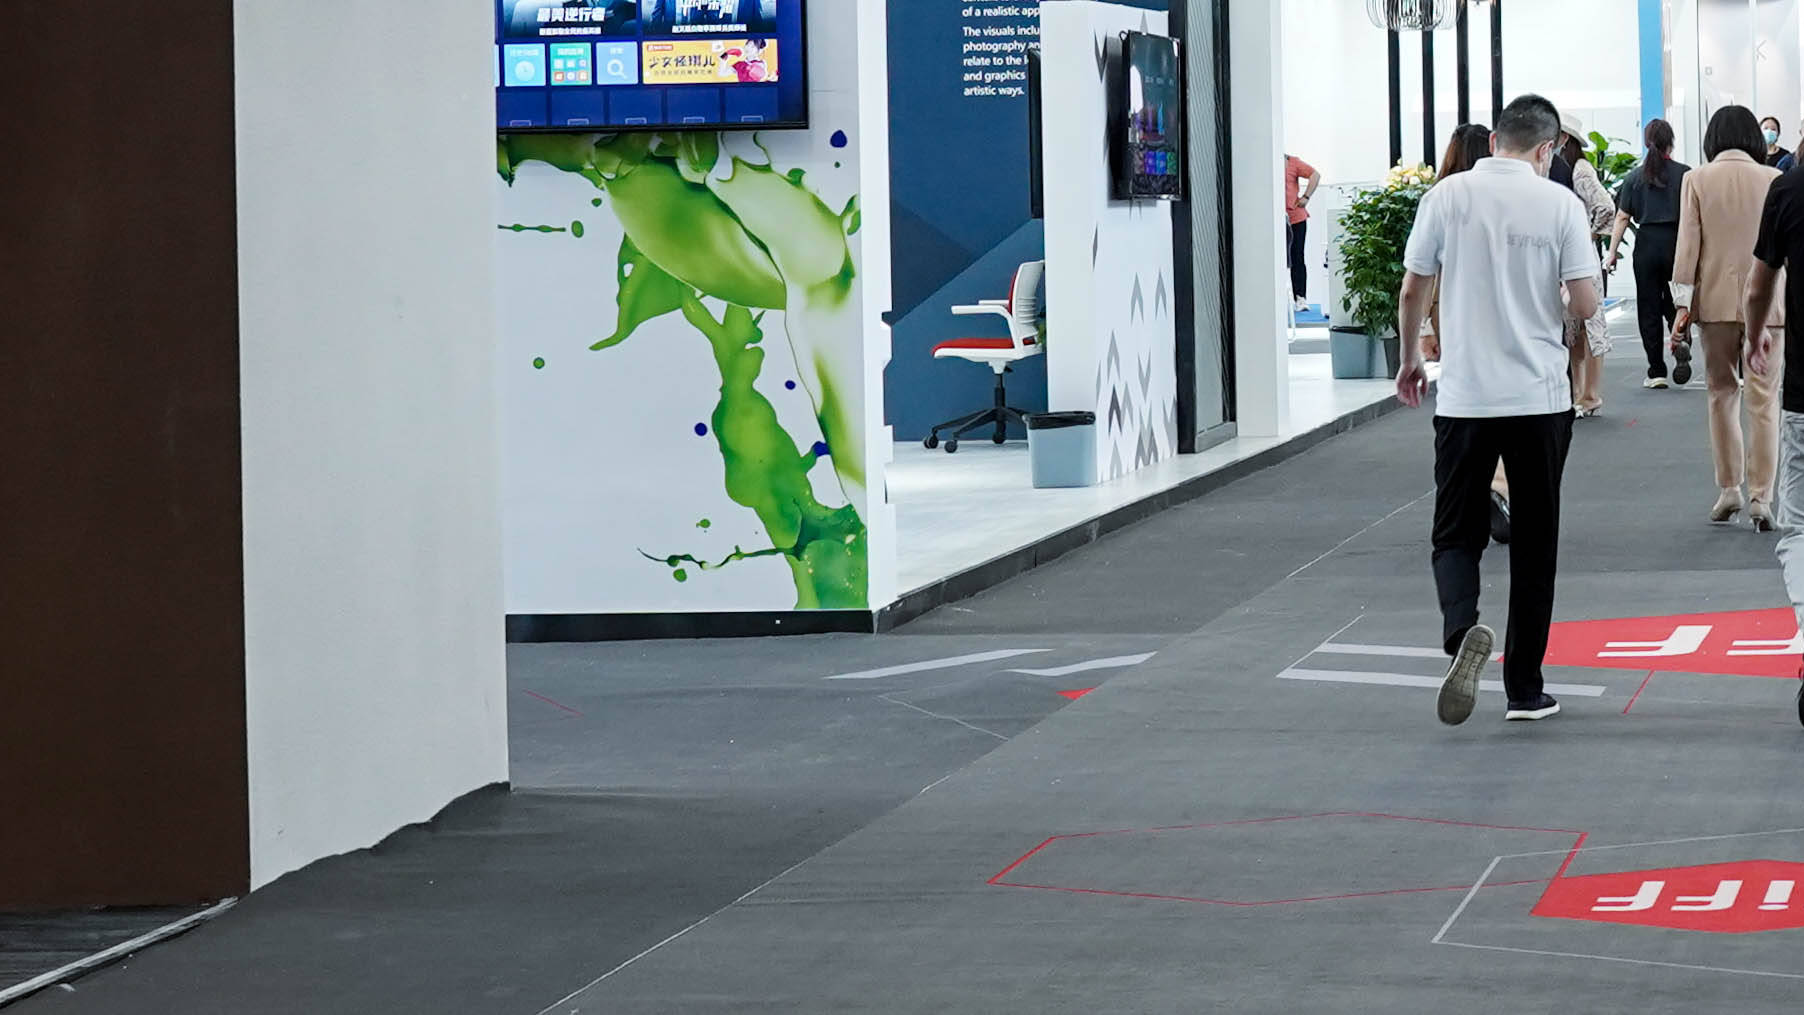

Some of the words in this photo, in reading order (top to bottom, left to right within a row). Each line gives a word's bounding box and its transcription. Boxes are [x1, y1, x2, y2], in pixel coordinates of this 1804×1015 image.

[962, 6, 973, 17] of
[975, 9, 981, 17] a
[983, 6, 1020, 17] realistic
[1021, 8, 1040, 18] app
[962, 26, 981, 36] The
[983, 25, 1015, 36] visuals
[1017, 25, 1040, 36] inclu
[963, 40, 1026, 54] photography
[963, 56, 991, 66] relate
[992, 57, 1003, 66] to
[1005, 55, 1022, 65] the
[963, 71, 982, 81] and
[984, 70, 1026, 83] graphics
[963, 85, 997, 96] artistic
[998, 86, 1025, 97] ways.
